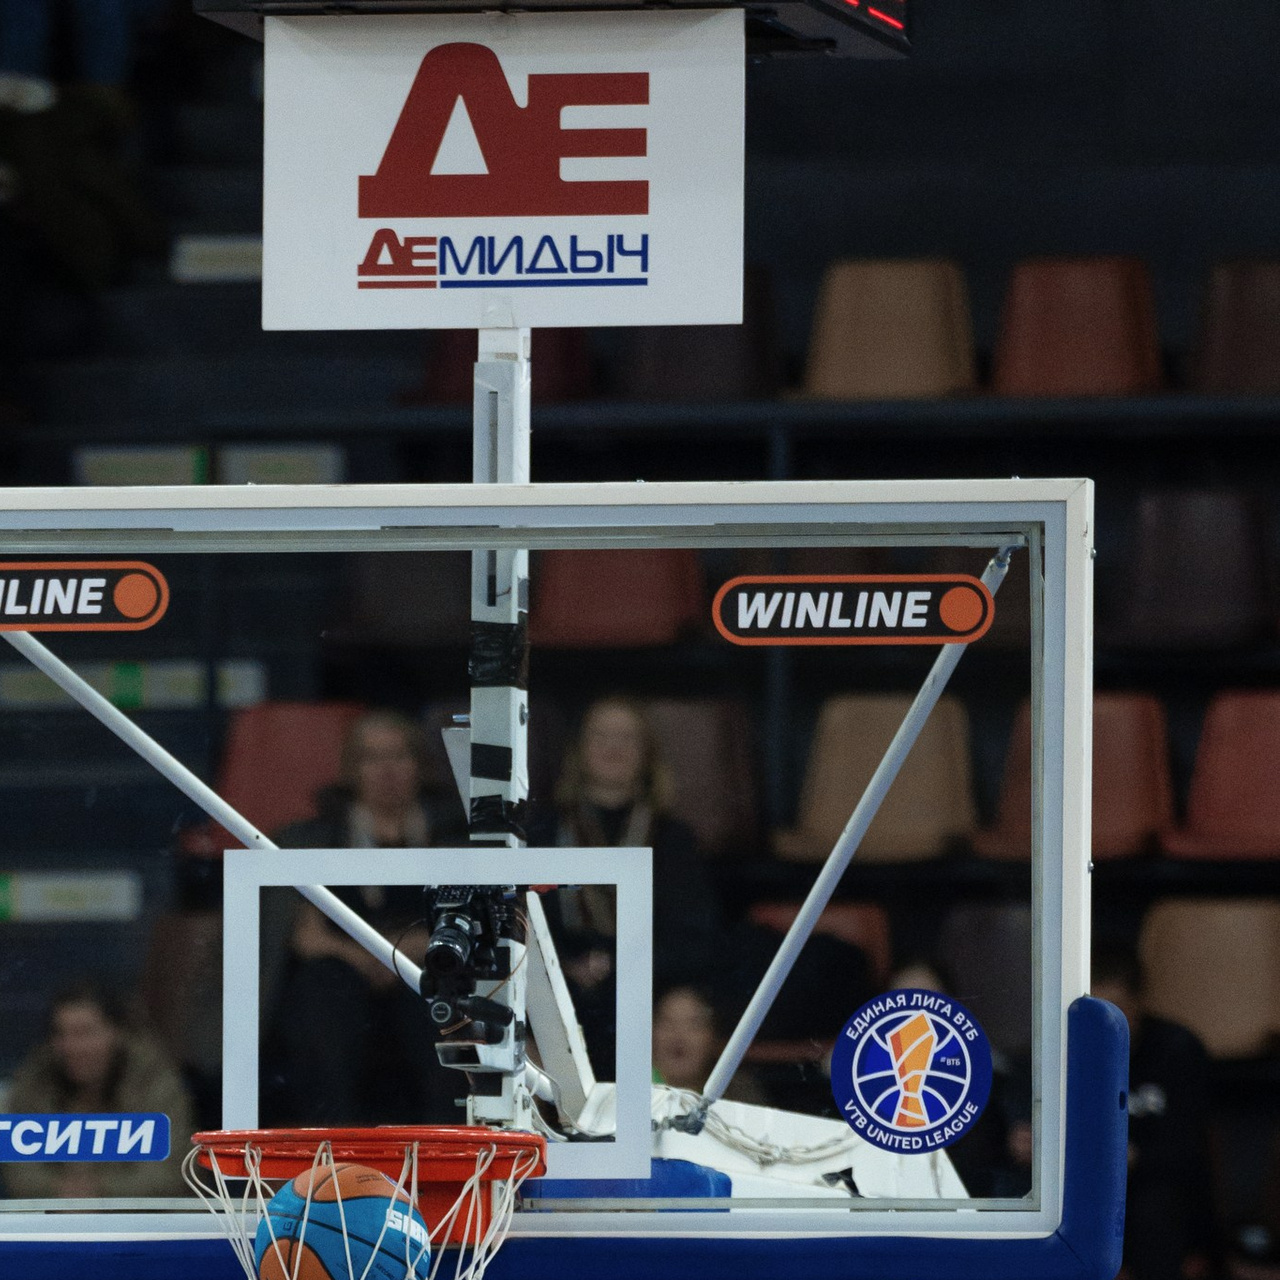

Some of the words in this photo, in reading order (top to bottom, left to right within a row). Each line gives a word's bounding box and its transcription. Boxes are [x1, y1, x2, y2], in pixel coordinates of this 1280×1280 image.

[357, 227, 650, 278] ДЕМИДЫЧ
[736, 590, 932, 629] WINLINE
[846, 994, 907, 1040] ЕДИНАЯ
[910, 993, 952, 1017] ЛИГА
[953, 1012, 979, 1041] ВТБ
[844, 1099, 867, 1129] VTB
[866, 1124, 923, 1150] UNITED
[925, 1101, 979, 1147] LEAGUE
